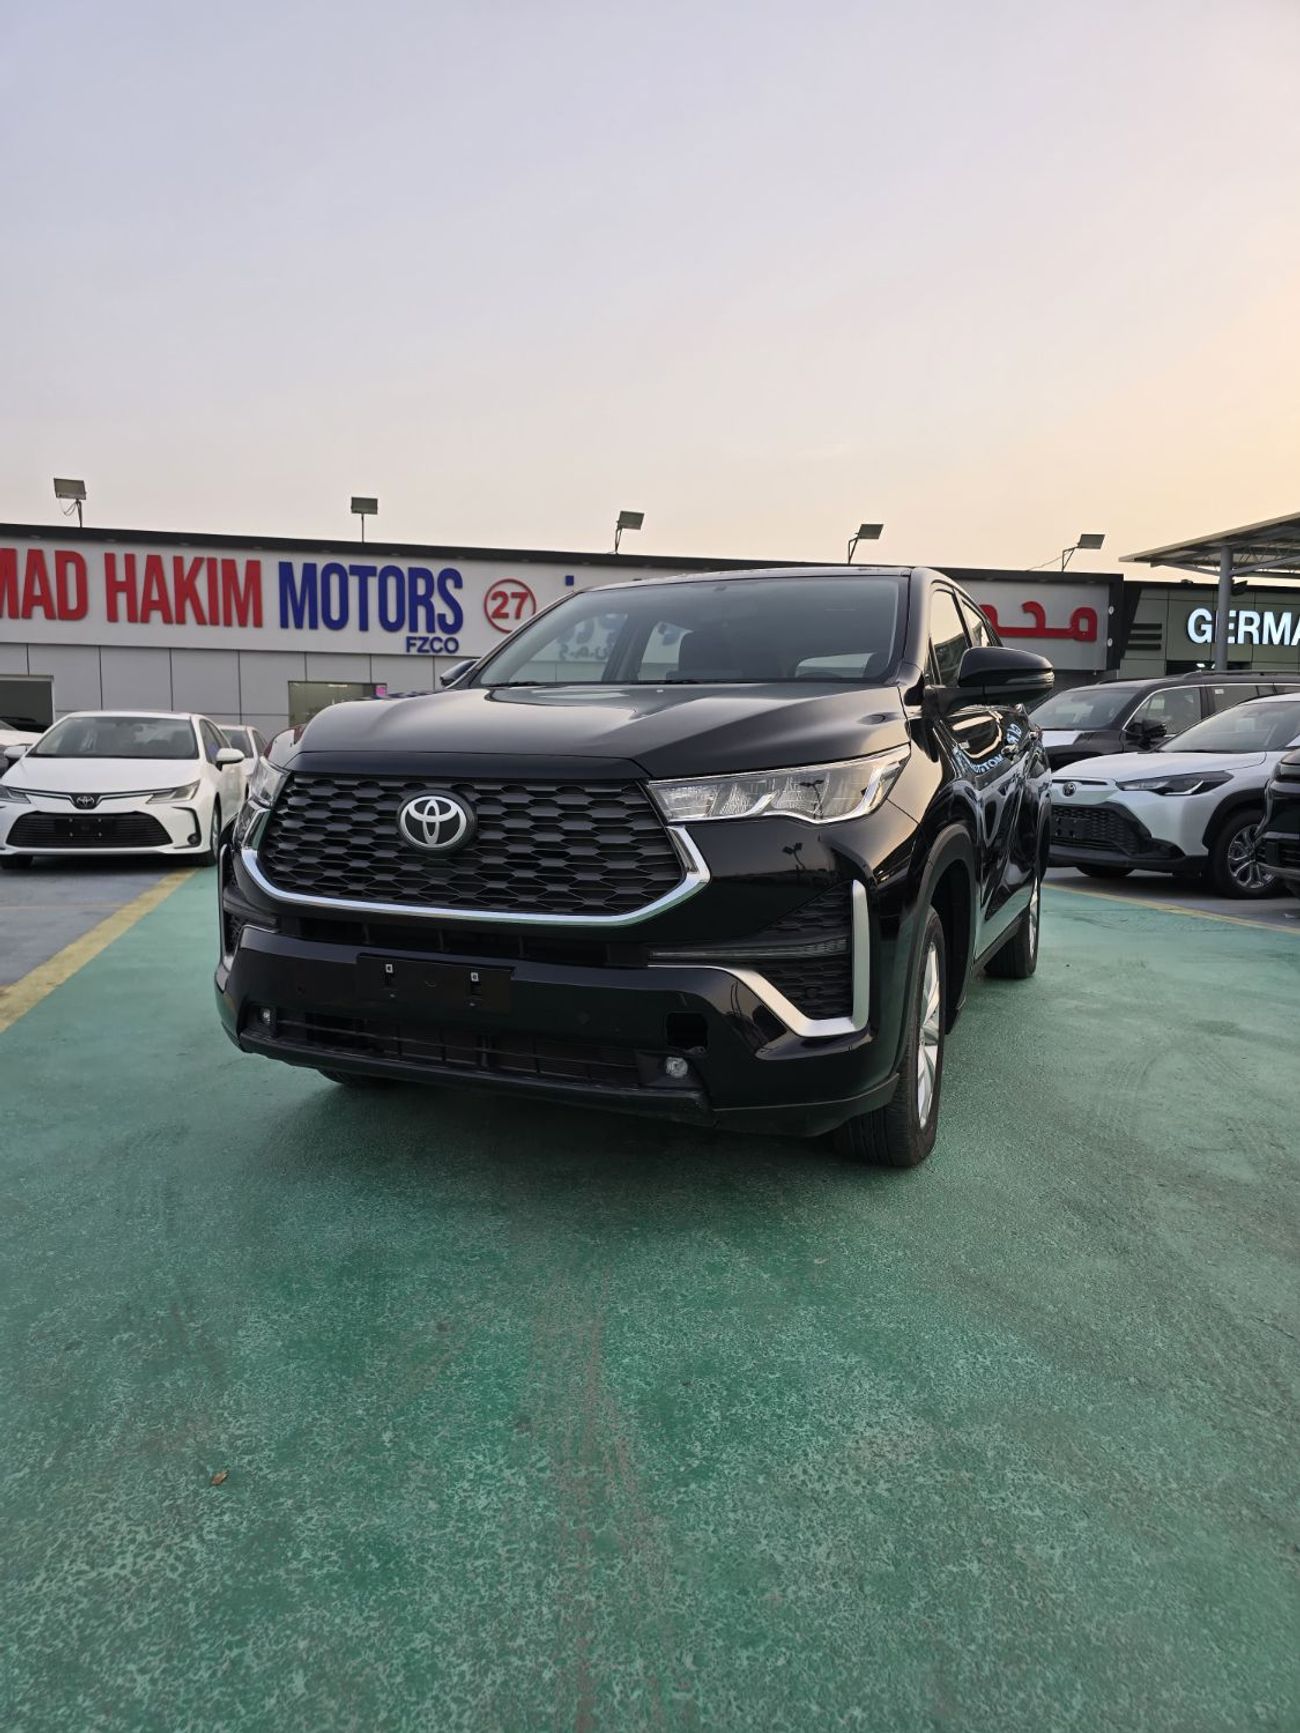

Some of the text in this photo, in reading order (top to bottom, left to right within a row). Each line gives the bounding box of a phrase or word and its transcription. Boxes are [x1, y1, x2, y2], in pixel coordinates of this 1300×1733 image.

[104, 553, 263, 628] HAKIM
[279, 561, 463, 635] MOTORS
[491, 591, 529, 620] 27
[405, 636, 459, 654] FZCO
